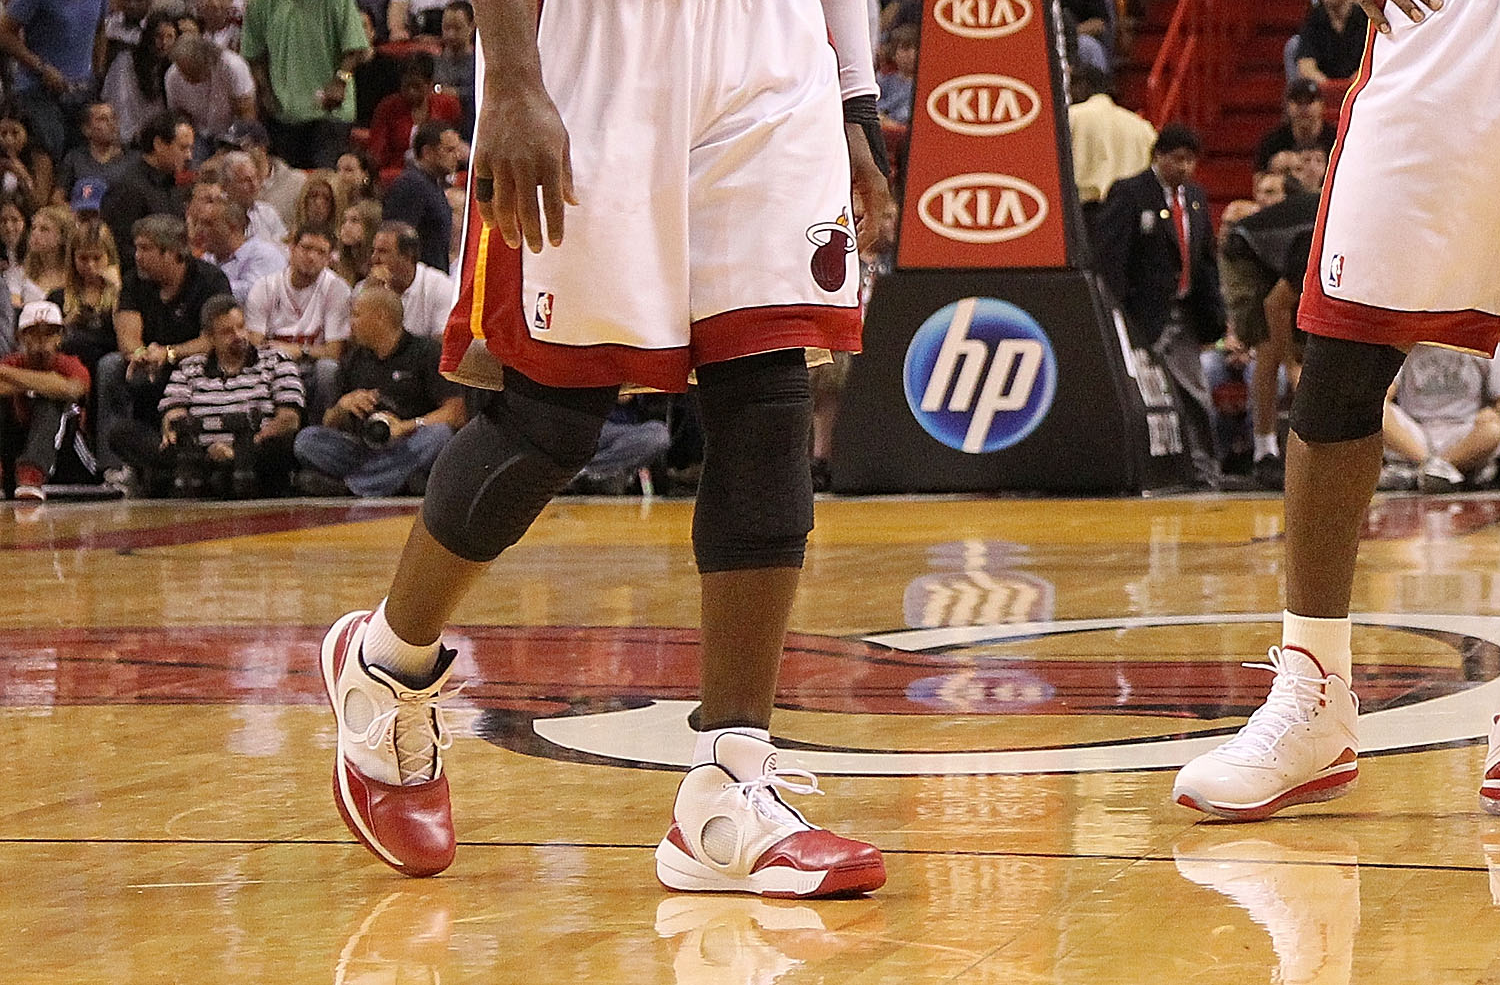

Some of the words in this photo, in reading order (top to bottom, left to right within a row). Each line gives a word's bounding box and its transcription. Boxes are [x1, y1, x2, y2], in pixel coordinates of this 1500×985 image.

[947, 88, 1022, 123] KIA
[941, 189, 1028, 227] KIA
[920, 296, 1043, 454] hp
